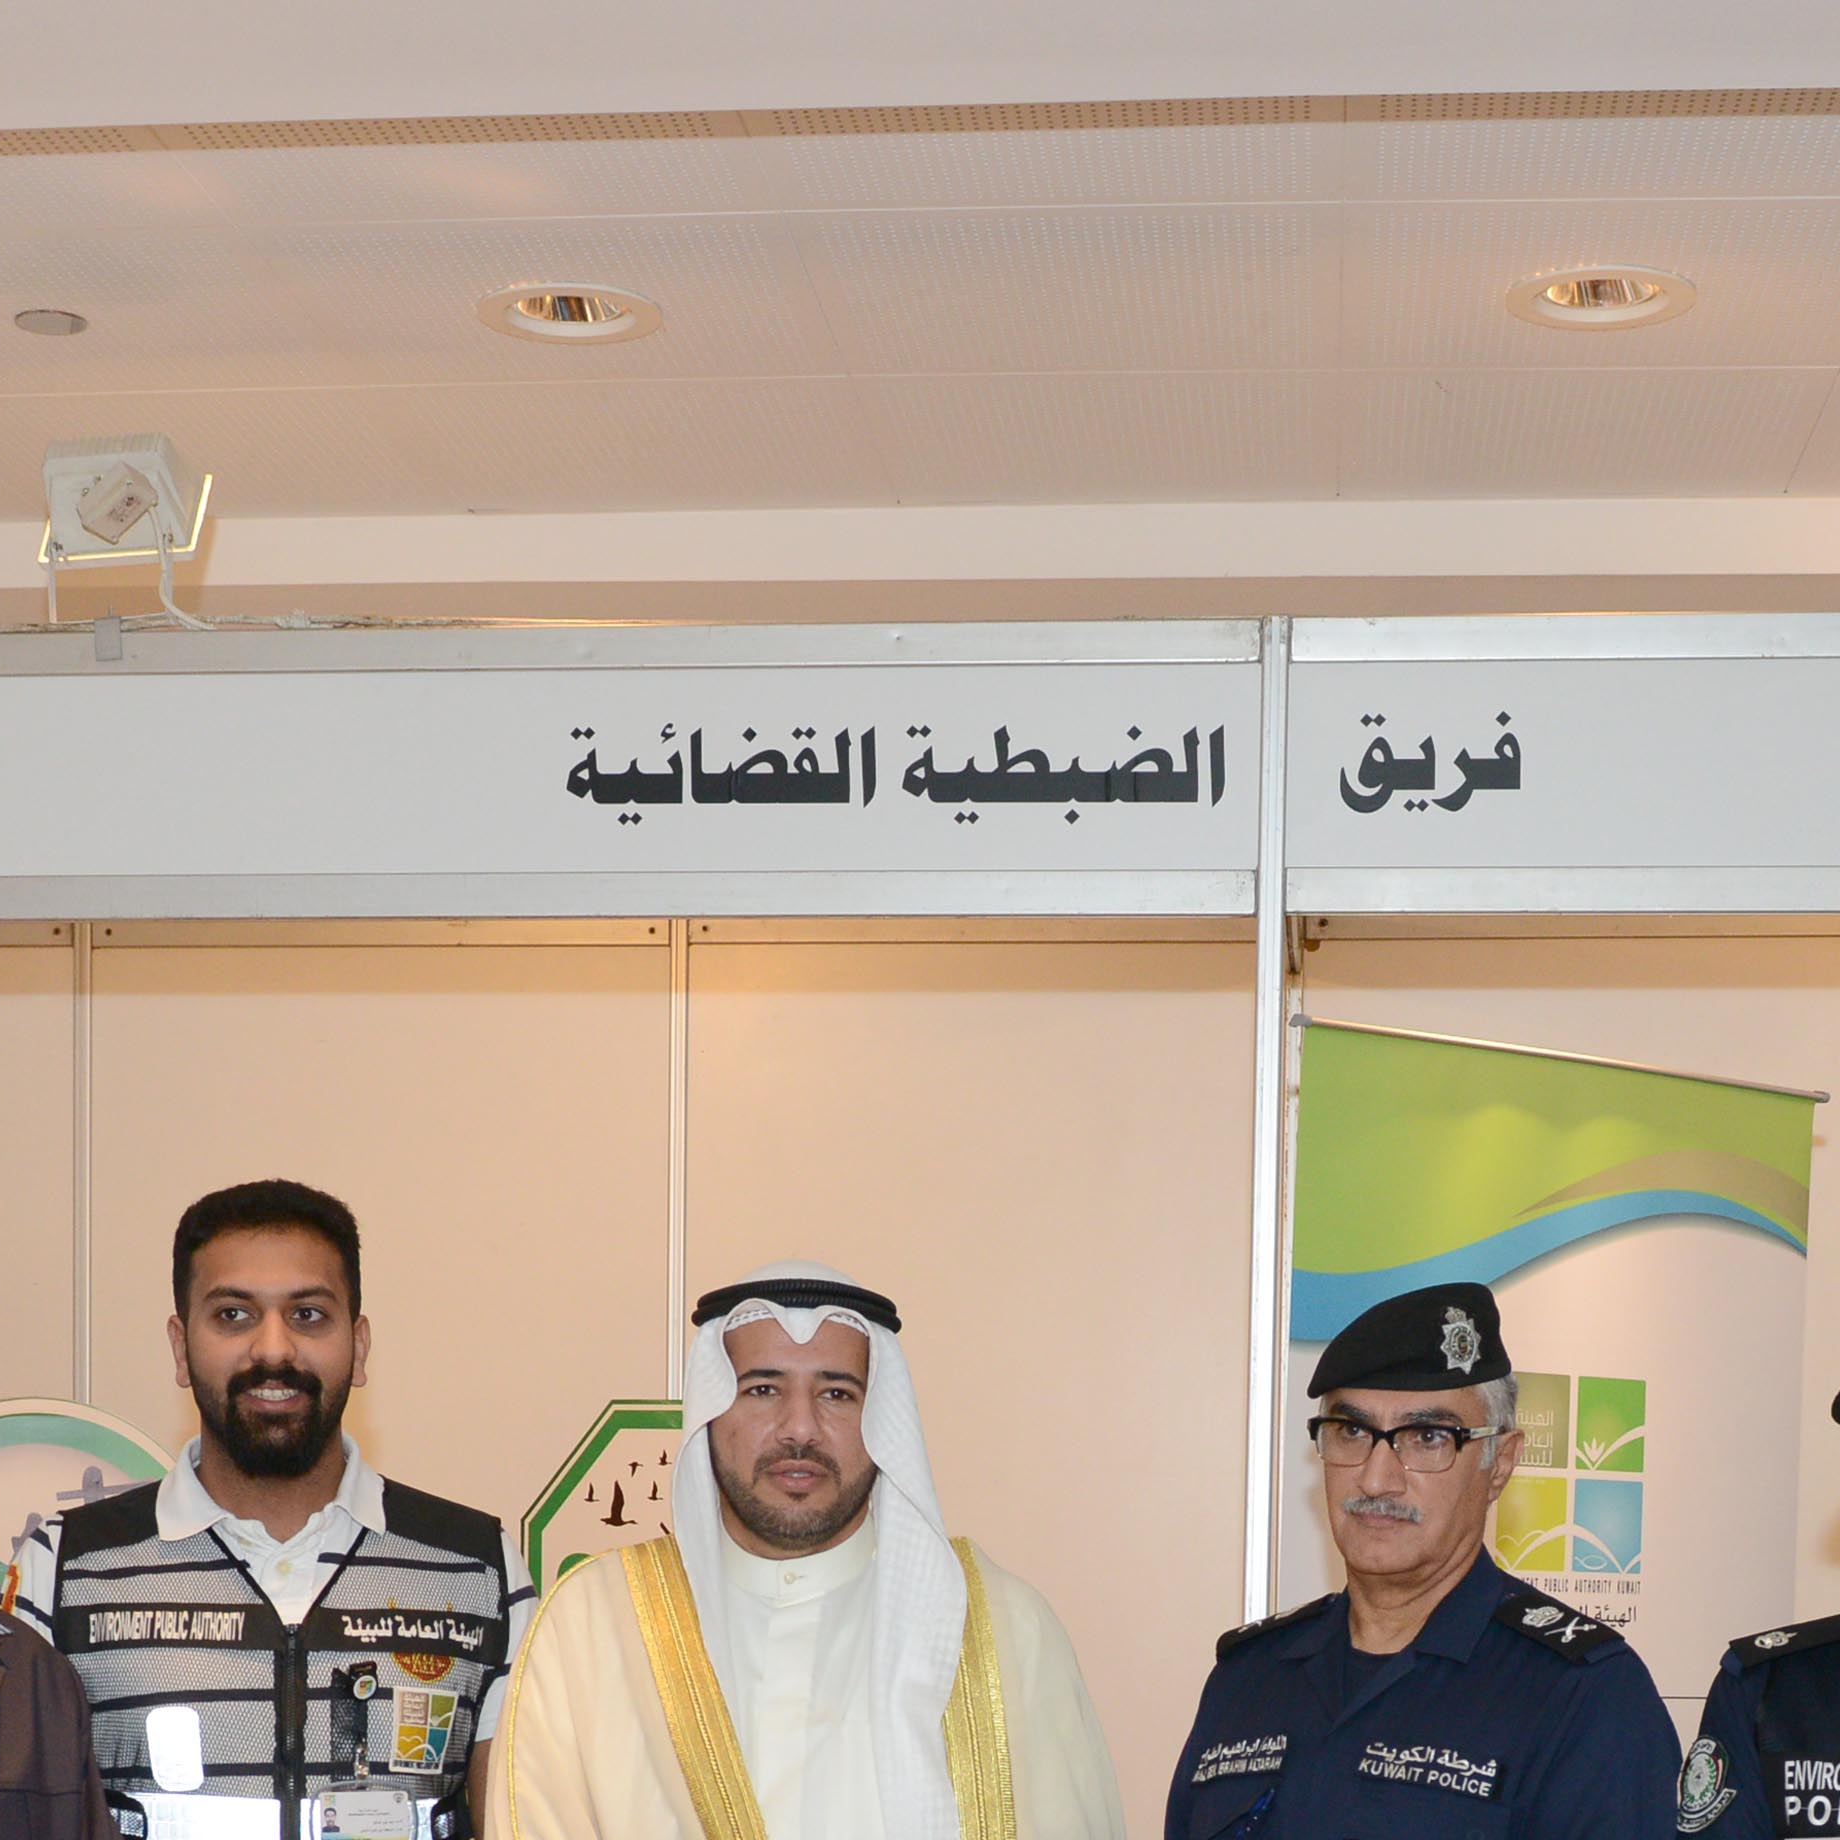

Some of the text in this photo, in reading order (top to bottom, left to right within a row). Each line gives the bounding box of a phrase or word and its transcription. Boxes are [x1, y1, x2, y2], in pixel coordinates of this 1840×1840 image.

[565, 710, 1522, 826] فريق الضبطية القضائية
[1523, 1431, 1553, 1448] العام
[1574, 1579, 1612, 1593] AUTHORITY
[1617, 1580, 1641, 1594] KUWAIT
[89, 1610, 246, 1644] ENVIRONMENT PUBLIC AUTHORITY
[394, 1615, 445, 1640] العامة
[1366, 1742, 1478, 1778] شرطة الكويت
[1358, 1758, 1493, 1797] KUWAIT POLICE
